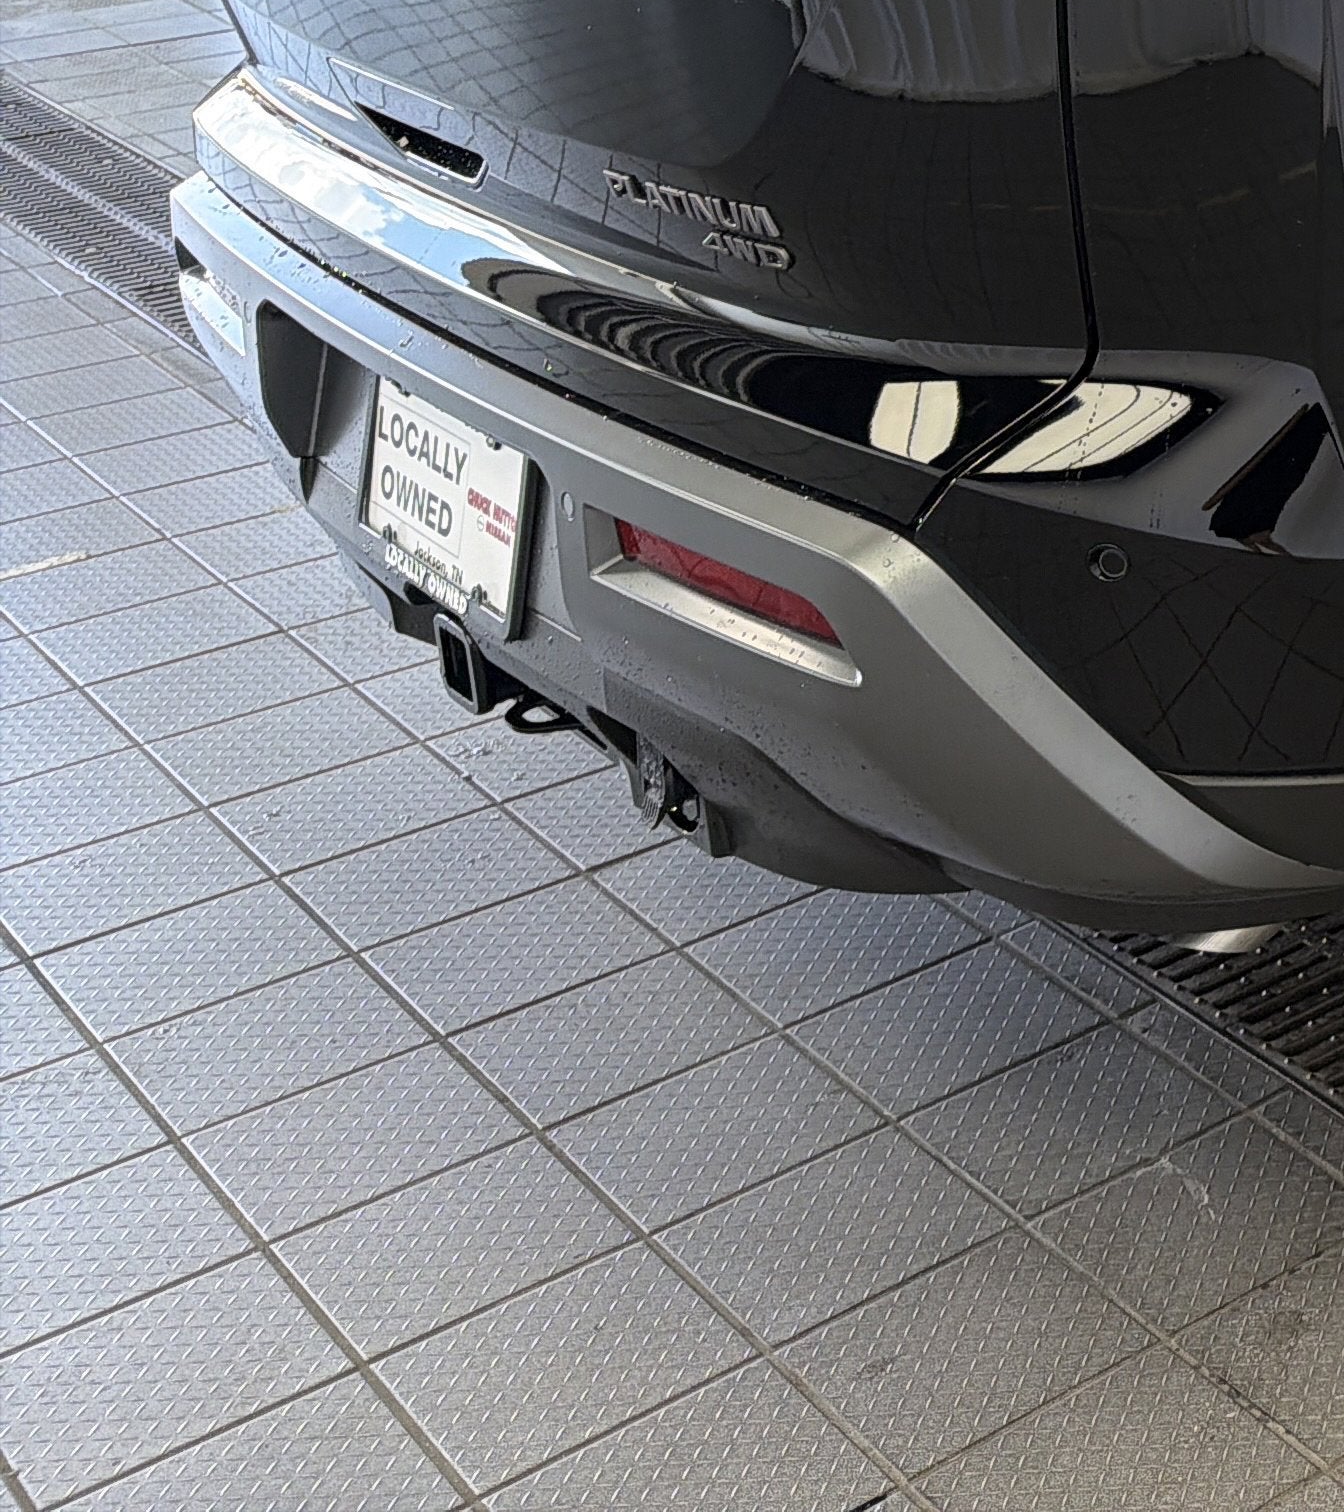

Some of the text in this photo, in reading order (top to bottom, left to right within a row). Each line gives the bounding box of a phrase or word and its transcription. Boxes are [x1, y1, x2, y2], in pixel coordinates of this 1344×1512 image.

[602, 168, 781, 238] PLATINUM
[702, 231, 793, 271] 4WD
[378, 405, 468, 486] LOCALLY
[380, 464, 453, 538] OWNED
[492, 502, 517, 534] HUTTO
[385, 543, 468, 615] LOCALLY OWNED
[414, 540, 464, 586] Jackson, TN
